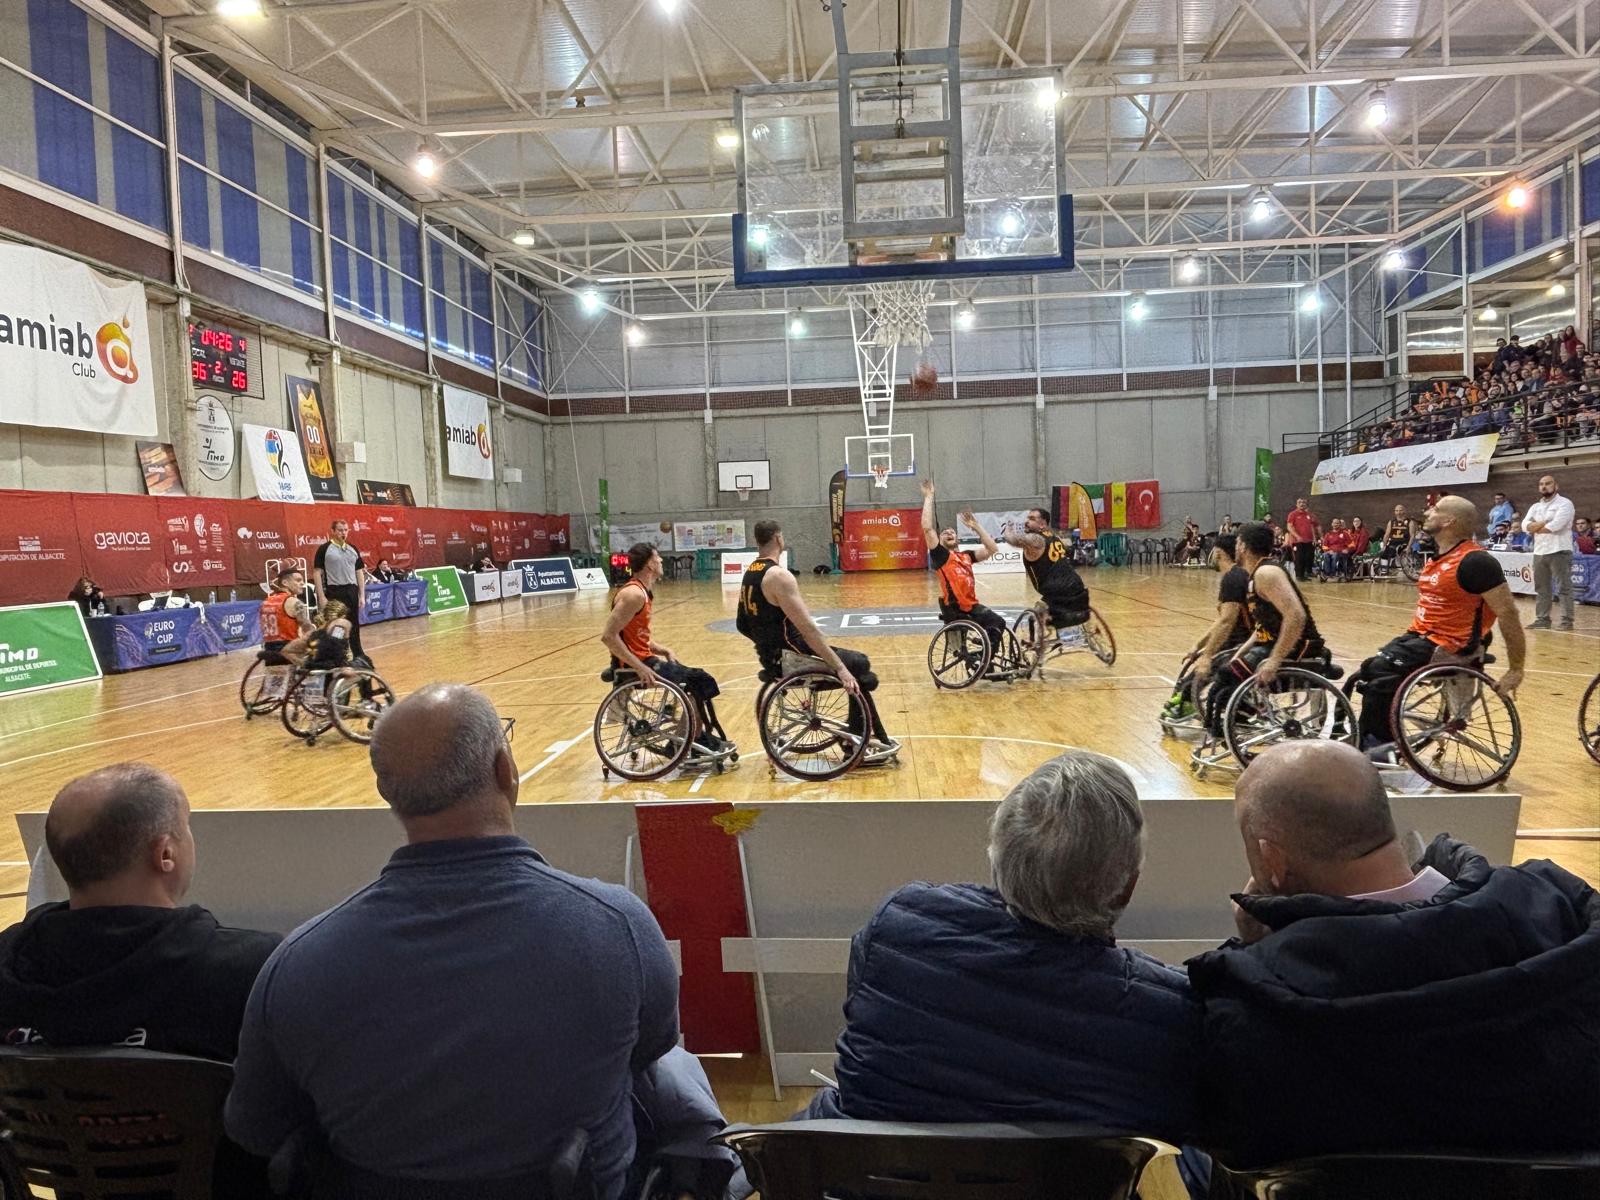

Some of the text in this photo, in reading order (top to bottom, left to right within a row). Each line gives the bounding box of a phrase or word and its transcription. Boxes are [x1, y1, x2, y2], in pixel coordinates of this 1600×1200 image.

[0, 313, 94, 360] amiab
[201, 329, 233, 352] 04:26
[72, 362, 96, 379] Club
[191, 360, 208, 381] 36
[231, 370, 246, 389] 26
[306, 424, 321, 444] 00
[446, 424, 477, 446] amiab
[863, 516, 888, 525] amiab
[94, 531, 151, 550] gaviota
[153, 620, 175, 632] EURO
[229, 613, 245, 624] EURO
[157, 633, 174, 644] CUP
[231, 625, 243, 636] CUP
